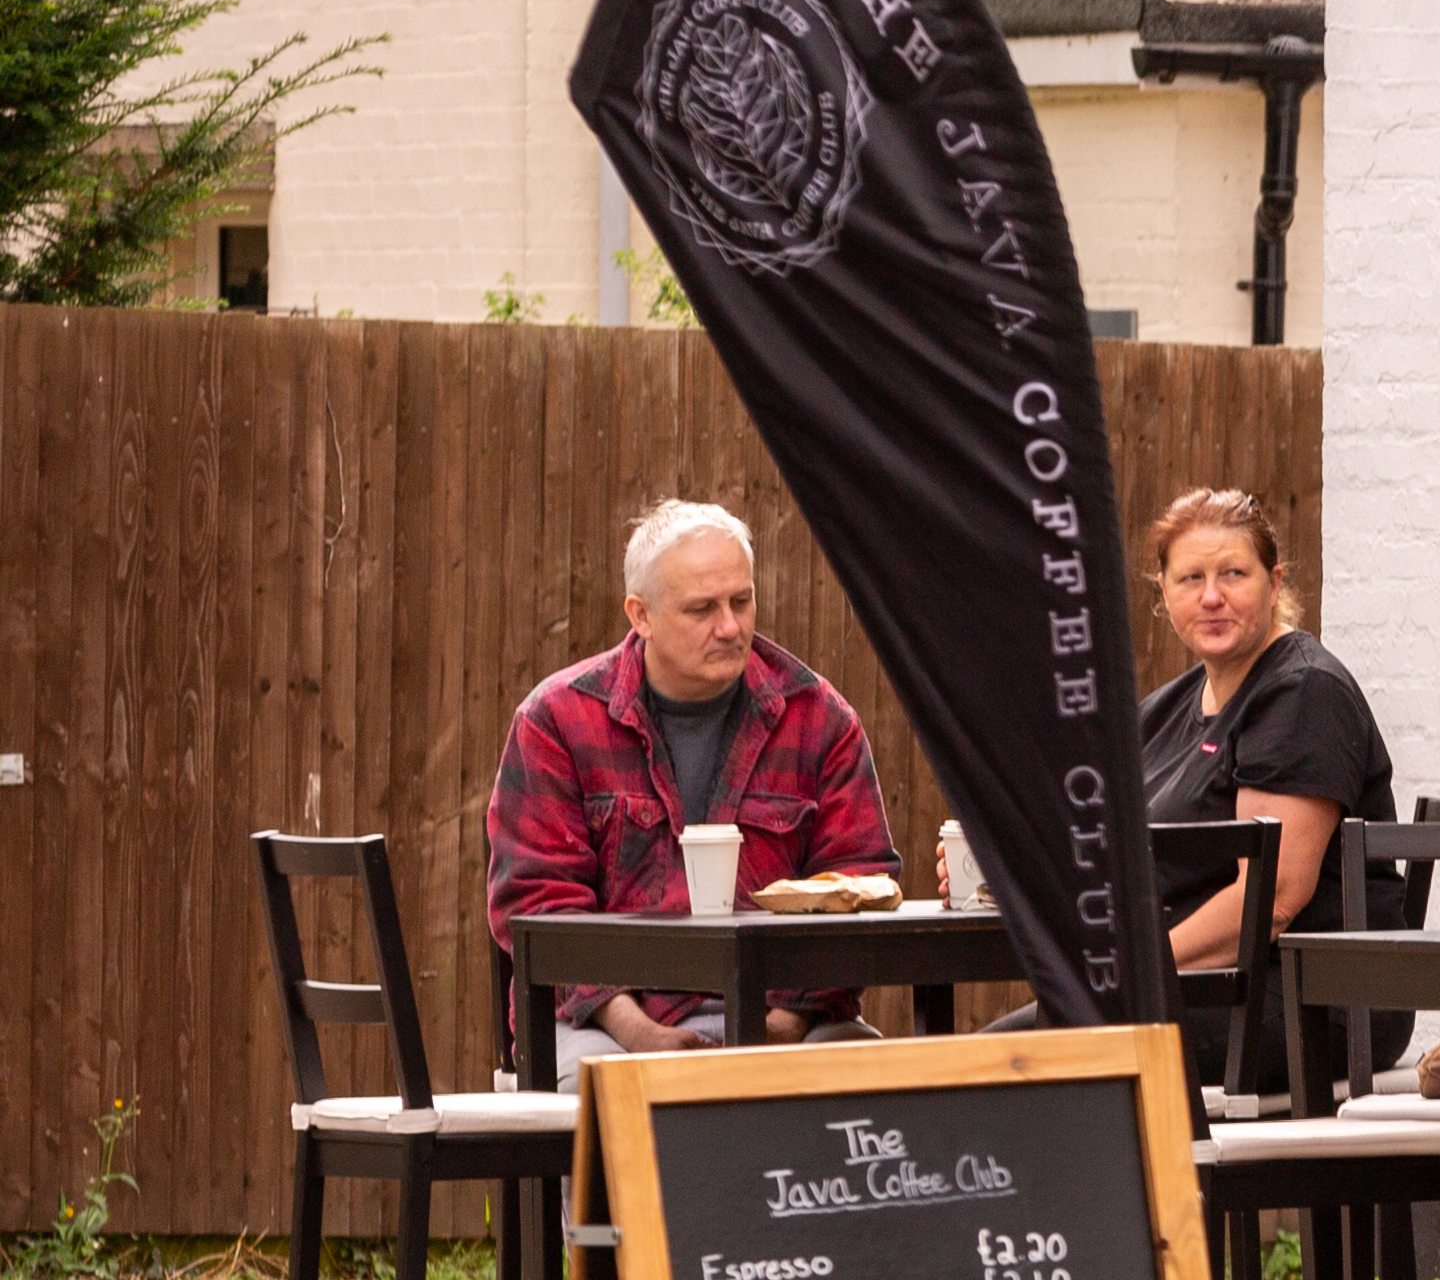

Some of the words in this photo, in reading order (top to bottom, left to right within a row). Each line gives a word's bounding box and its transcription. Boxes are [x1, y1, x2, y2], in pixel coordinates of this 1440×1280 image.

[936, 118, 1038, 349] JAVA
[1013, 381, 1099, 718] COFFEE
[1064, 764, 1120, 994] CLUB
[826, 1118, 907, 1158] The
[763, 1168, 861, 1210] Java
[866, 1161, 953, 1200] Coffee
[955, 1153, 1013, 1192] Club
[977, 1228, 1068, 1266] £2.20
